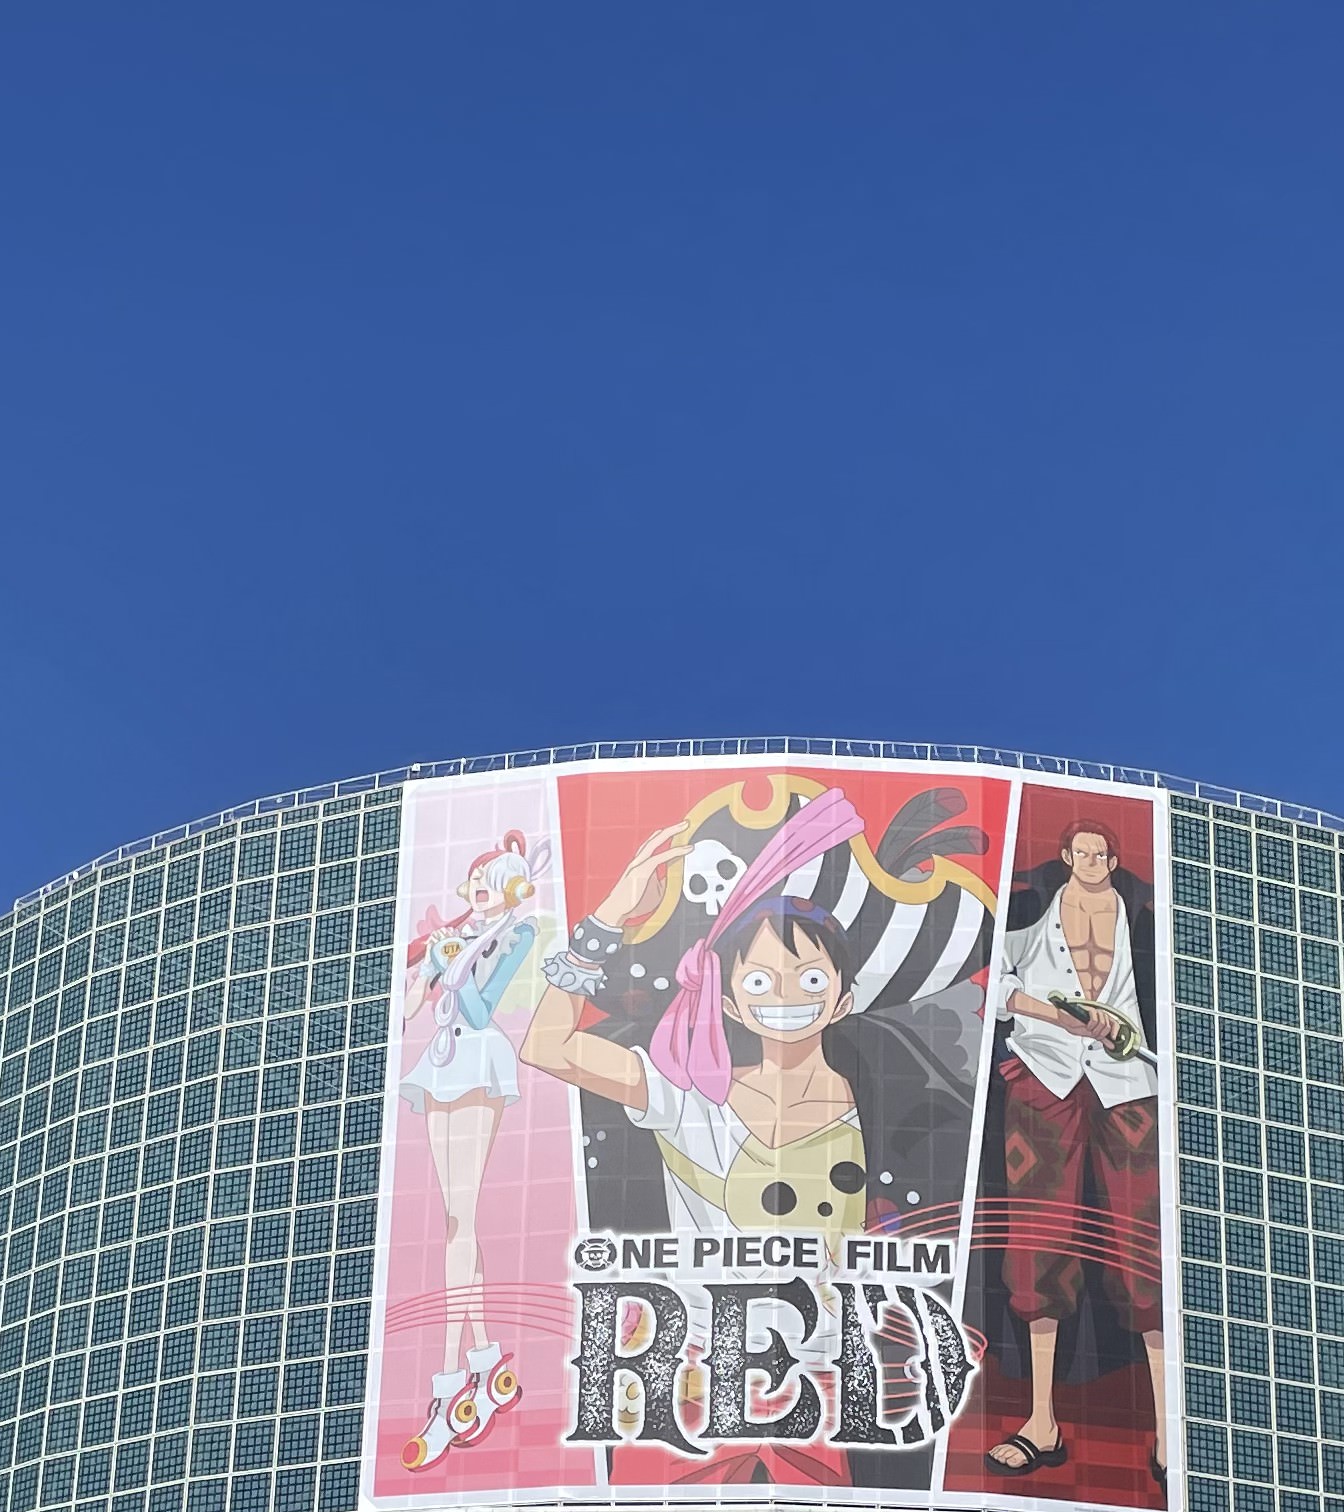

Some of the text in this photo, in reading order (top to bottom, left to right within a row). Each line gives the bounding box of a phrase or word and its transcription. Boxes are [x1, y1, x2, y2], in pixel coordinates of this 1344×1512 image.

[693, 1236, 819, 1269] PIECE
[847, 1240, 952, 1274] FILM
[564, 1277, 976, 1454] RED
